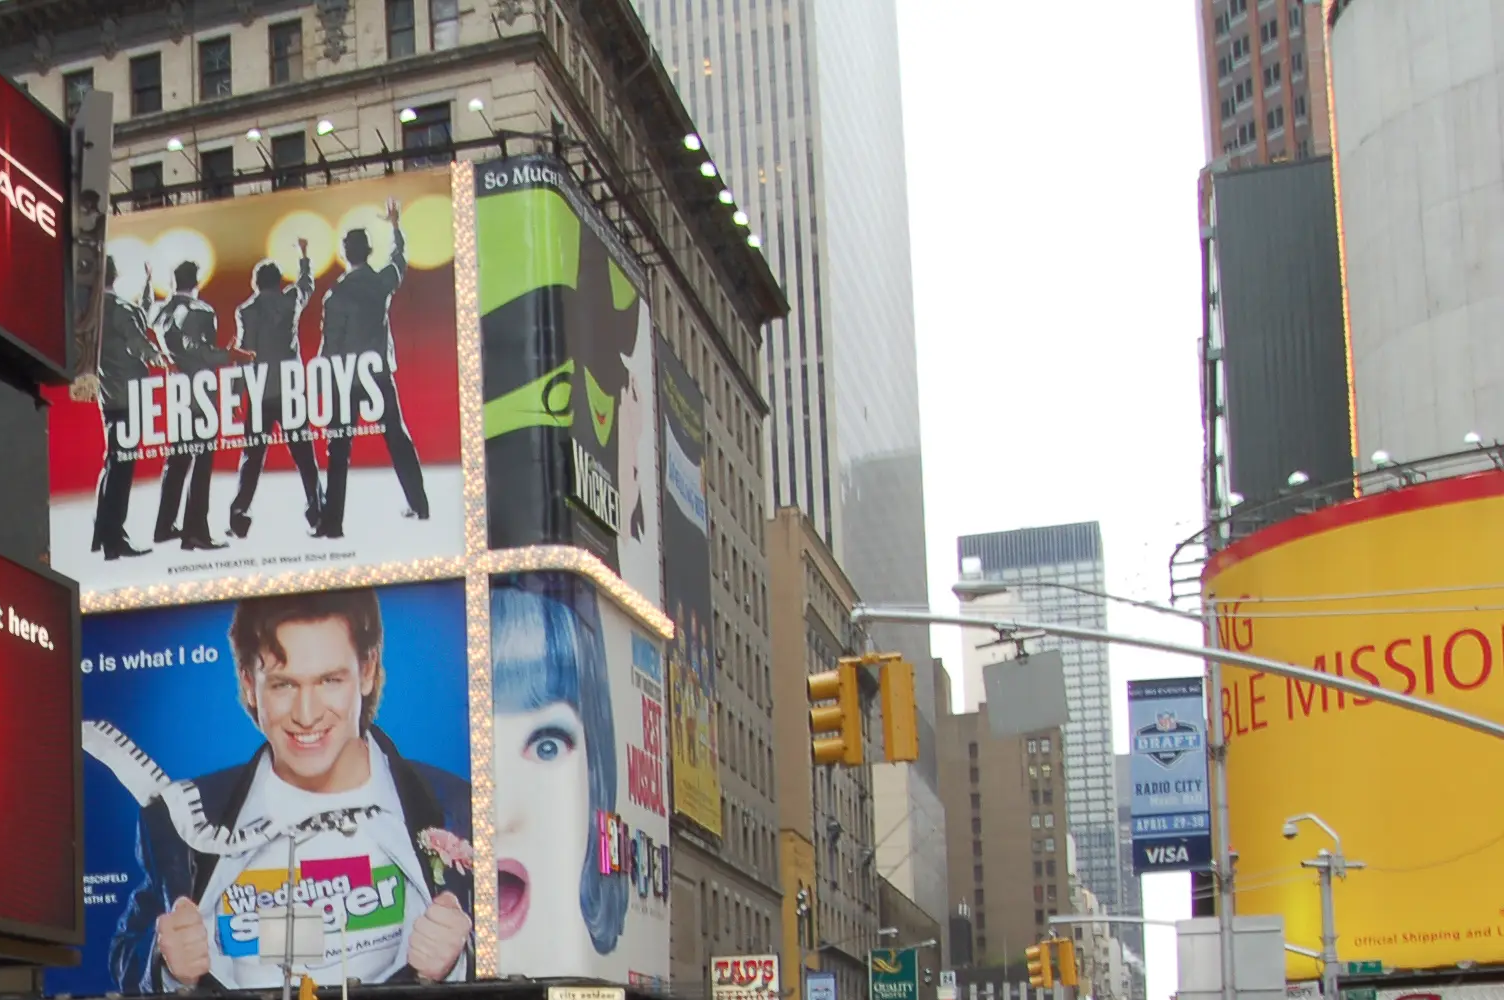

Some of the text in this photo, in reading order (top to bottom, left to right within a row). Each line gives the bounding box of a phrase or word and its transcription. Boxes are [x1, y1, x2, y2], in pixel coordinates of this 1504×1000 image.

[484, 170, 509, 189] So
[115, 350, 387, 449] JERSEY BOYS
[160, 445, 176, 457] the
[178, 443, 204, 456] story
[206, 440, 219, 451] of
[220, 436, 260, 451] Frankie
[262, 431, 289, 445] Valli
[301, 428, 319, 442] The
[346, 424, 386, 438] Seasons
[8, 605, 55, 651] here.
[99, 652, 117, 673] is
[122, 648, 174, 670] what
[178, 645, 186, 665] I
[190, 644, 219, 664] do
[1284, 623, 1504, 721] MISSIO
[1137, 735, 1198, 749] DRAFT
[1135, 779, 1202, 796] RADIO CITY
[1136, 818, 1168, 832] APRIL
[1145, 845, 1190, 864] VISA
[226, 883, 256, 901] the
[1354, 934, 1398, 948] Official
[1401, 932, 1461, 945] Shipping
[1466, 926, 1492, 939] and
[714, 959, 774, 985] TAD'S
[873, 982, 915, 993] QUALITY
